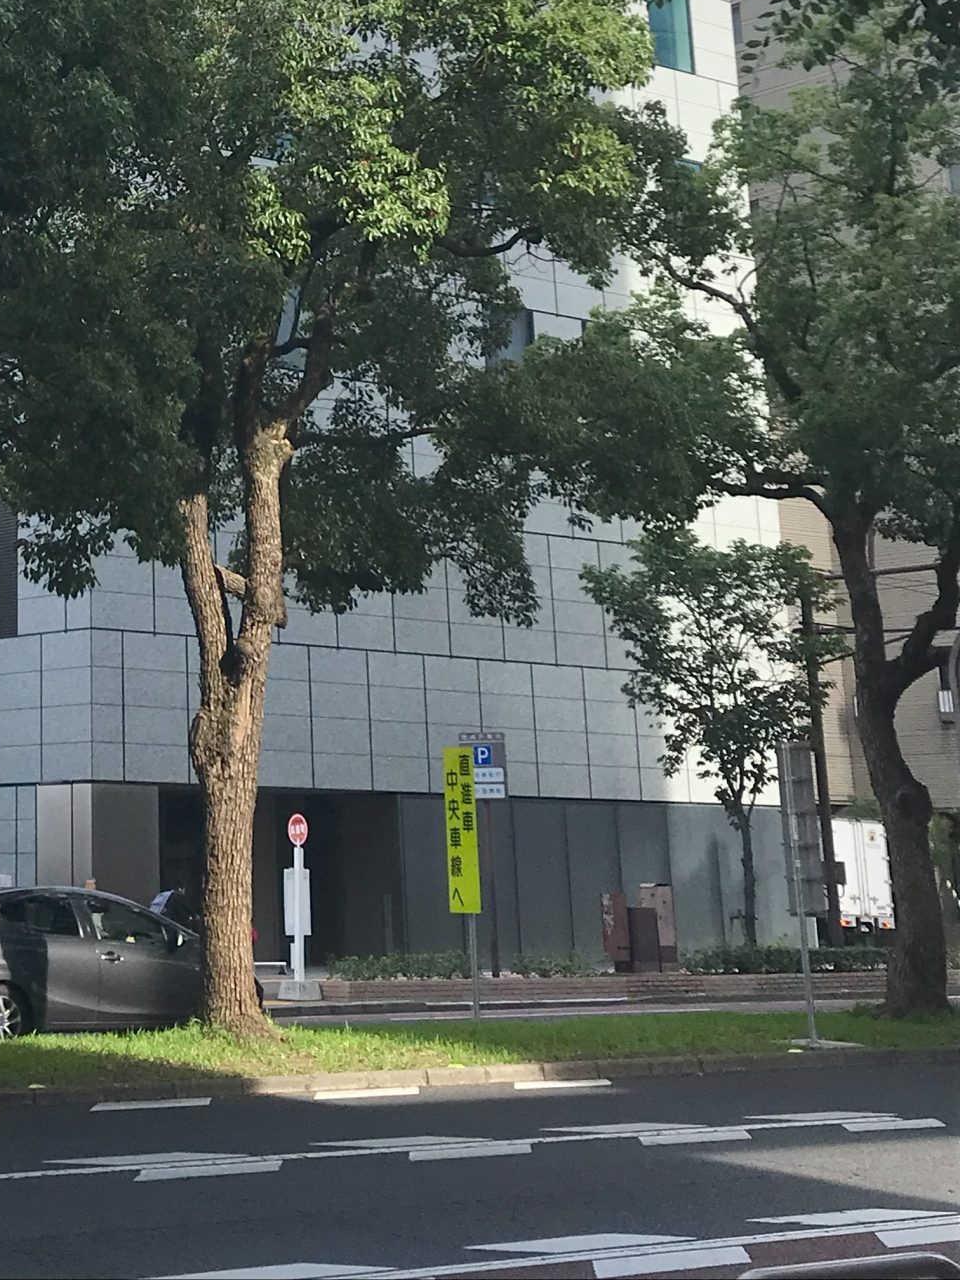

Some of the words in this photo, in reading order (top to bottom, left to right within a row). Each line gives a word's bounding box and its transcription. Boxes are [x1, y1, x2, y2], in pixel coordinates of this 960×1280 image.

[458, 754, 474, 833] 直進車
[477, 747, 489, 763] P
[446, 768, 464, 907] 中央車線へ
